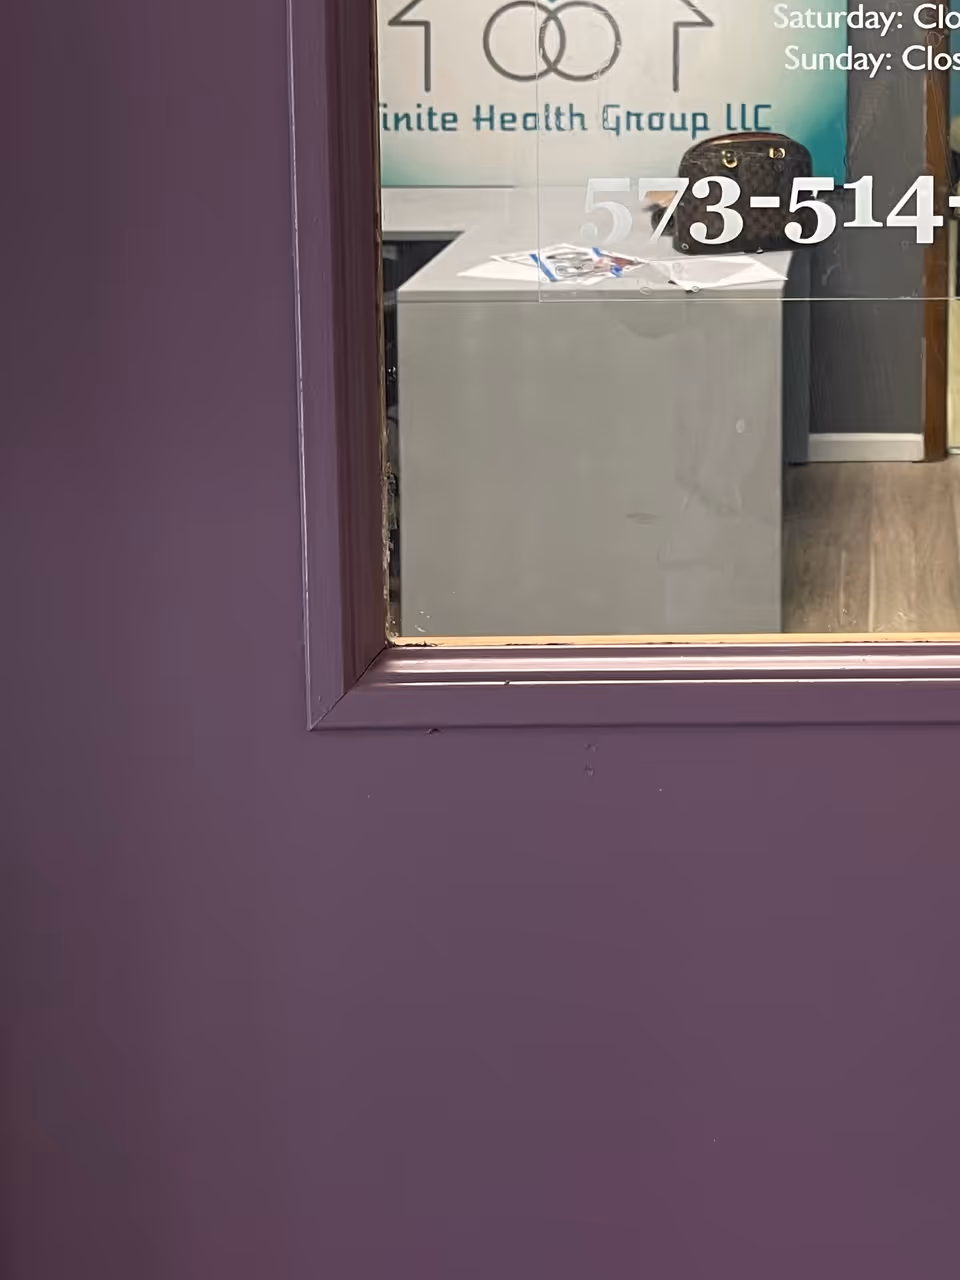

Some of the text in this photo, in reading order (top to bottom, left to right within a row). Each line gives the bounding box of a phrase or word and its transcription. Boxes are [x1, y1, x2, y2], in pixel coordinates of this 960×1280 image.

[773, 4, 904, 37] Saturday:
[784, 45, 892, 78] Sunday:
[473, 104, 588, 131] Health
[602, 104, 710, 139] Group
